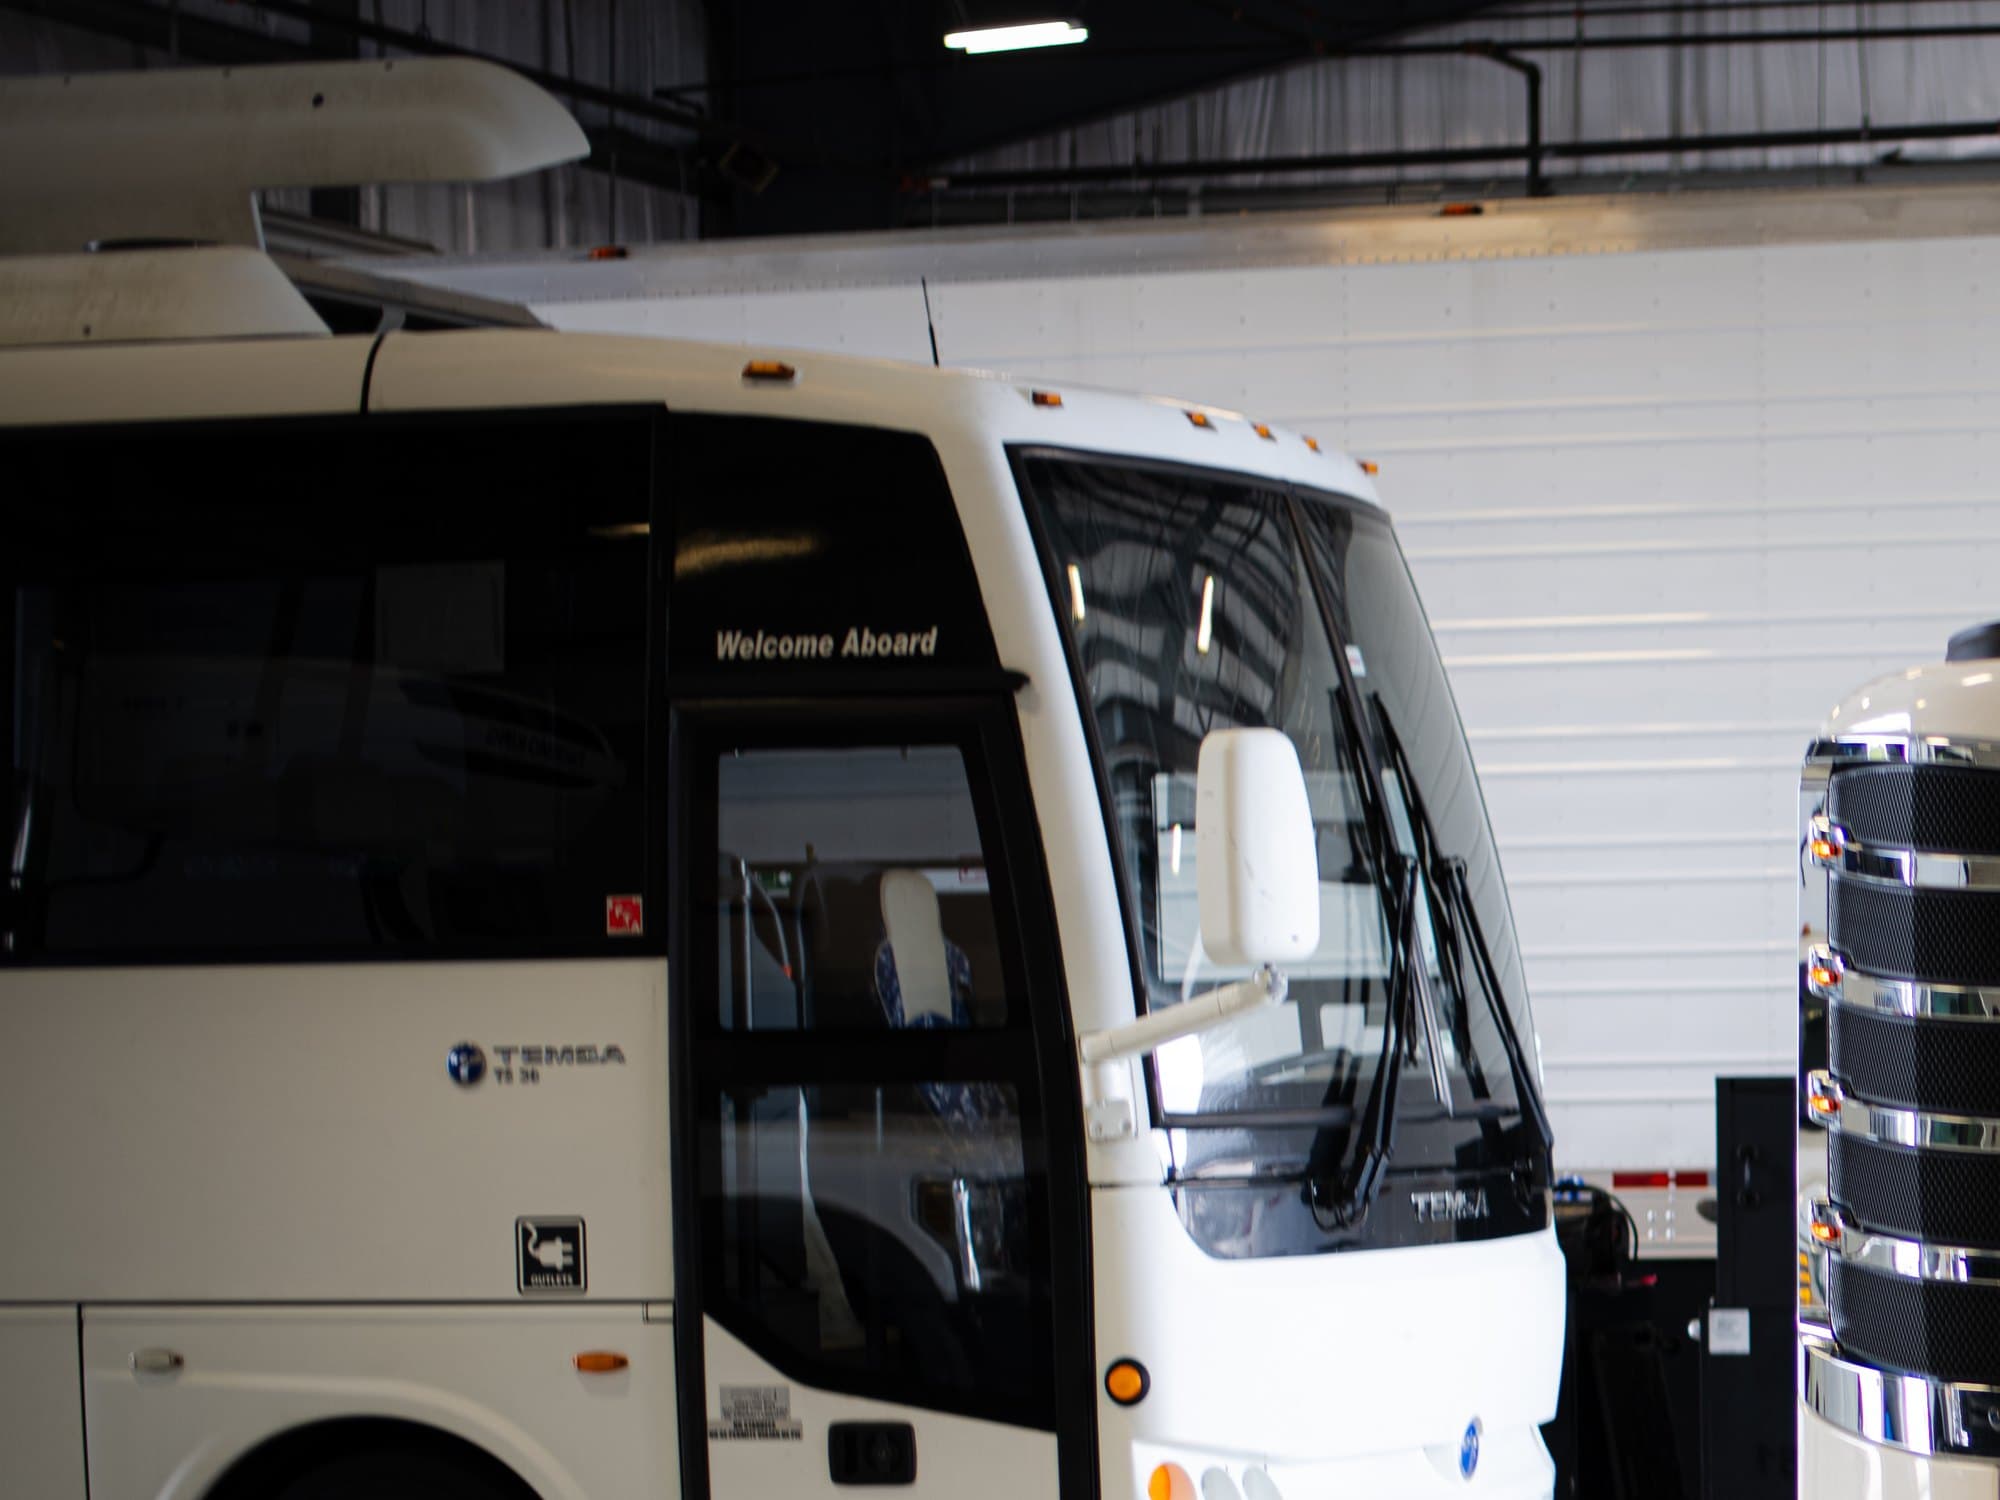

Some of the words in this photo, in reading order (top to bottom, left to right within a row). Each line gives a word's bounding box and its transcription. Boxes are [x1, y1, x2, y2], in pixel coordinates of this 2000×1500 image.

[716, 630, 834, 660] Welcome
[842, 625, 938, 658] Aboard
[493, 1044, 626, 1066] TEMSA
